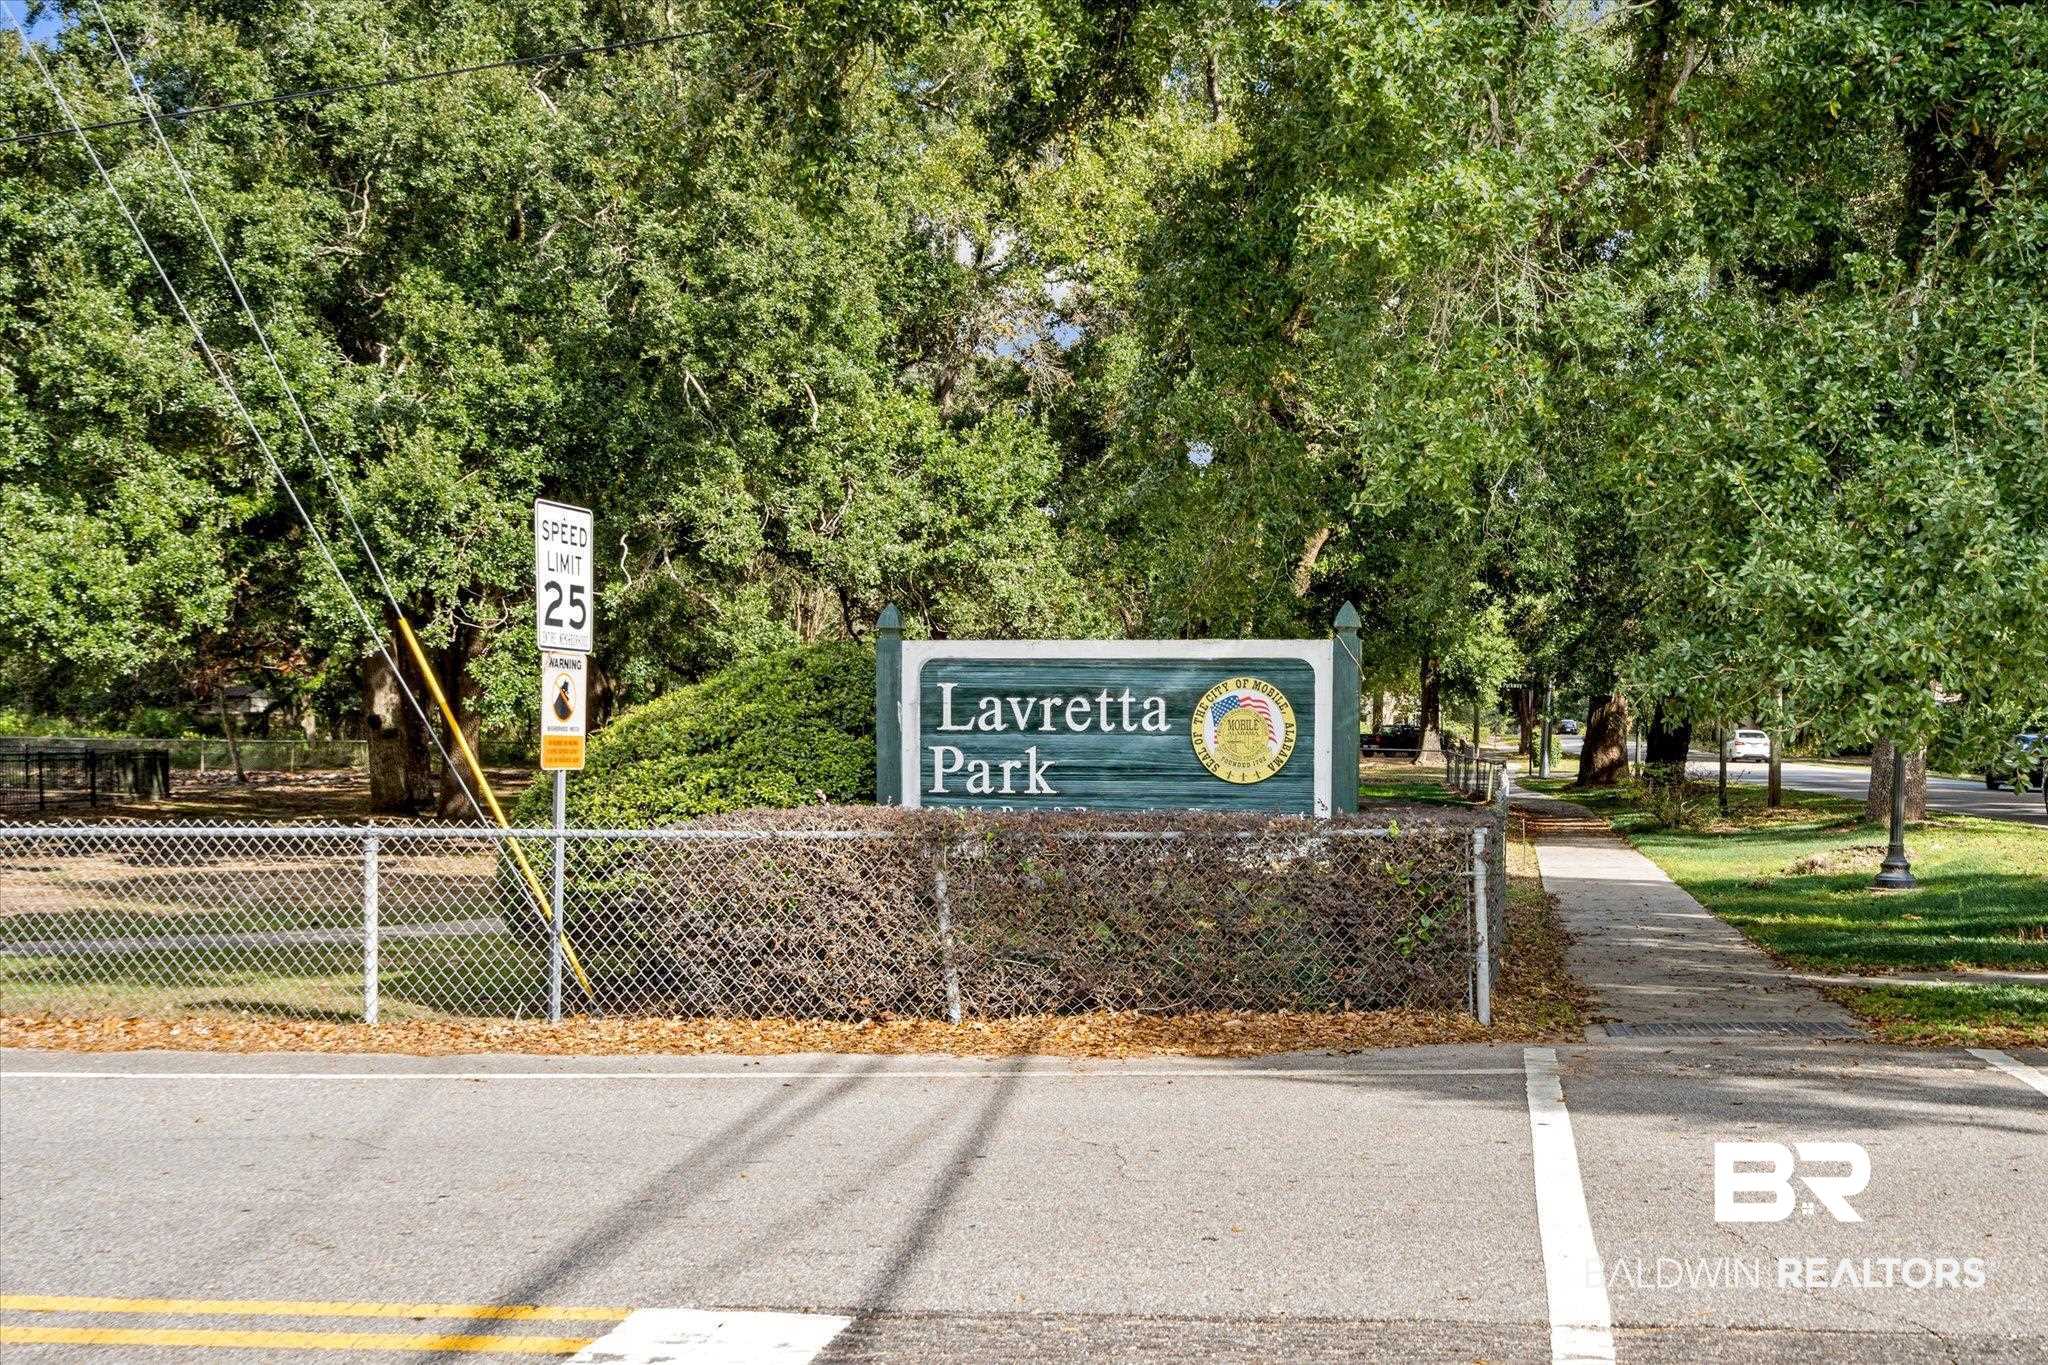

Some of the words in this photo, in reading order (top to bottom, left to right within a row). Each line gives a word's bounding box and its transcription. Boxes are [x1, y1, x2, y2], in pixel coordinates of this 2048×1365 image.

[542, 519, 588, 548] SPEED
[547, 551, 583, 576] LIMIT
[544, 580, 587, 630] 25
[548, 656, 582, 671] WARNING
[1206, 682, 1230, 703] CITY
[1235, 679, 1249, 689] OF
[936, 681, 1171, 733] Lavretta
[1252, 680, 1289, 714] MOBILE,
[1194, 704, 1209, 724] THE
[1227, 719, 1259, 731] MOBILE
[1193, 732, 1203, 745] OF
[1267, 722, 1295, 771] ALABAMA
[927, 745, 1058, 795] Park
[1198, 748, 1220, 772] SEAL
